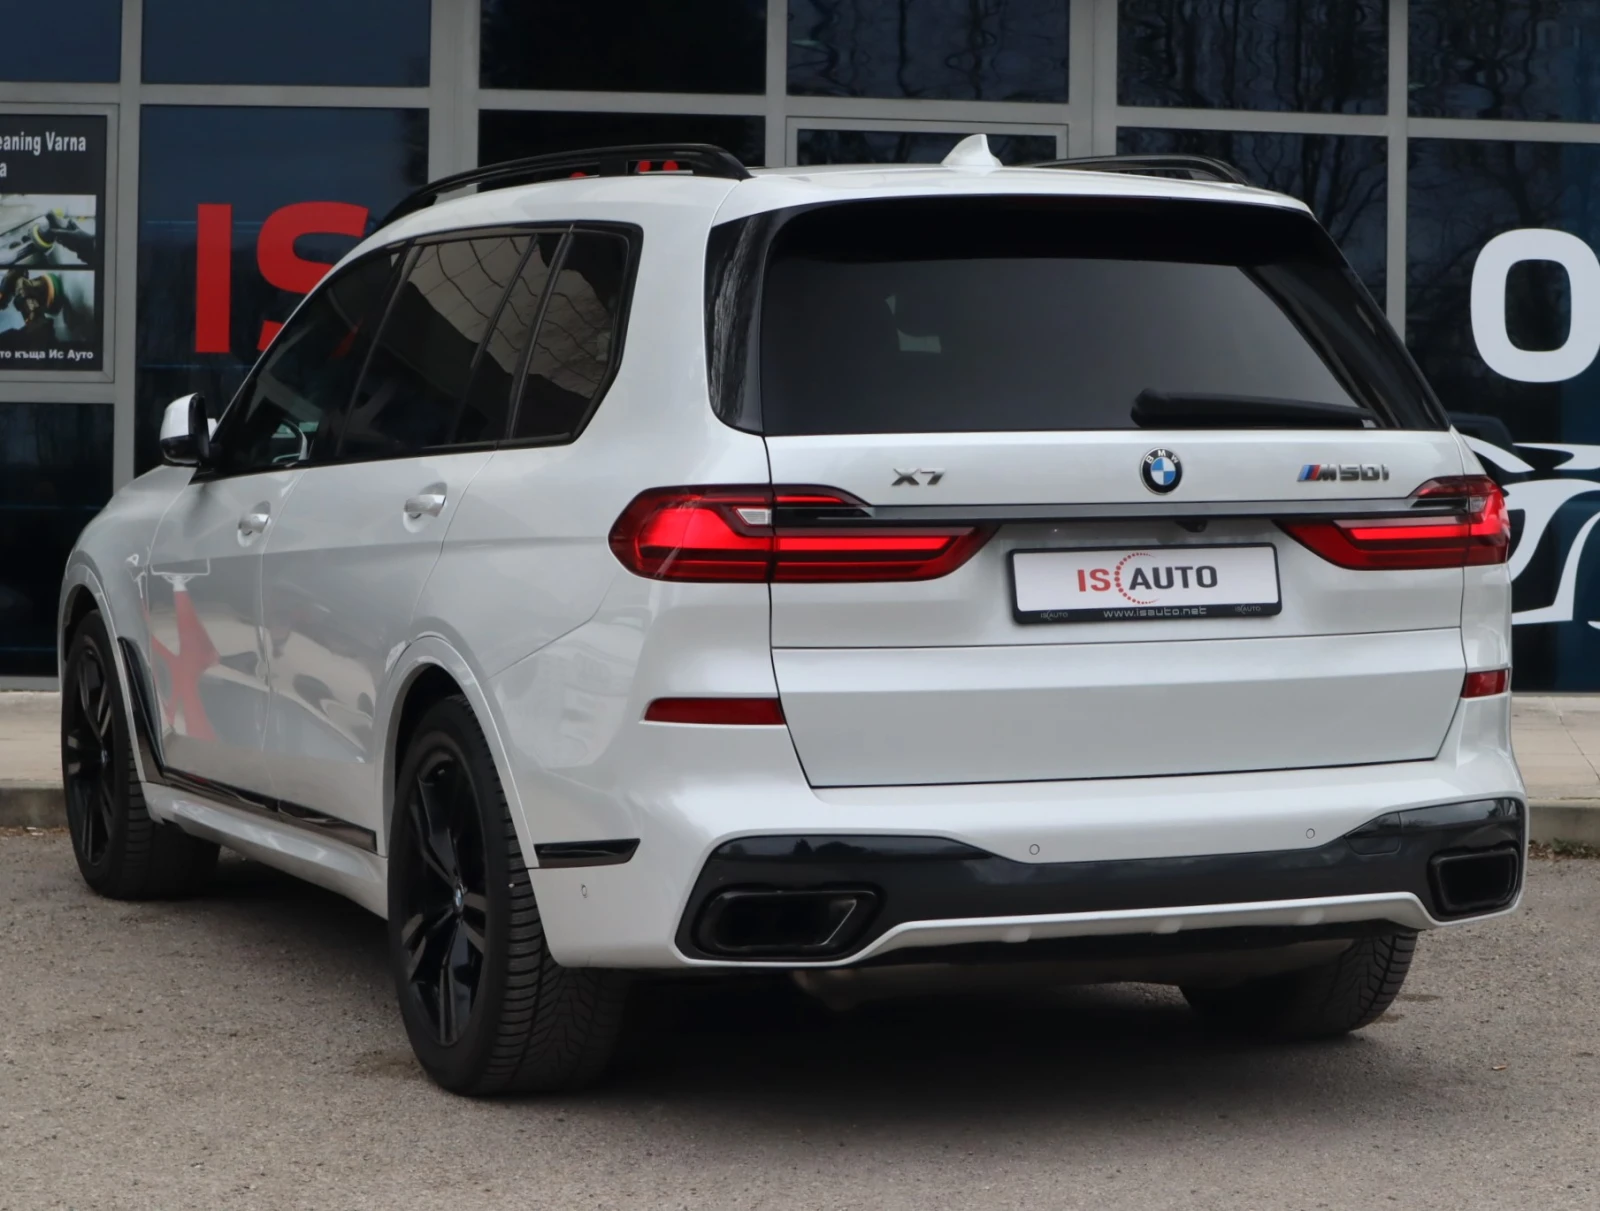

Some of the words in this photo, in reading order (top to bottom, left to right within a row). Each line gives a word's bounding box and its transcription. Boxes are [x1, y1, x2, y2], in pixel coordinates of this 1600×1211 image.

[45, 131, 87, 152] Varna
[15, 351, 46, 360] къща
[49, 349, 64, 359] Ис
[67, 349, 94, 361] Ауто
[1145, 449, 1179, 464] BMW
[891, 468, 946, 486] X7
[1103, 606, 1207, 618] www.isauto.net
